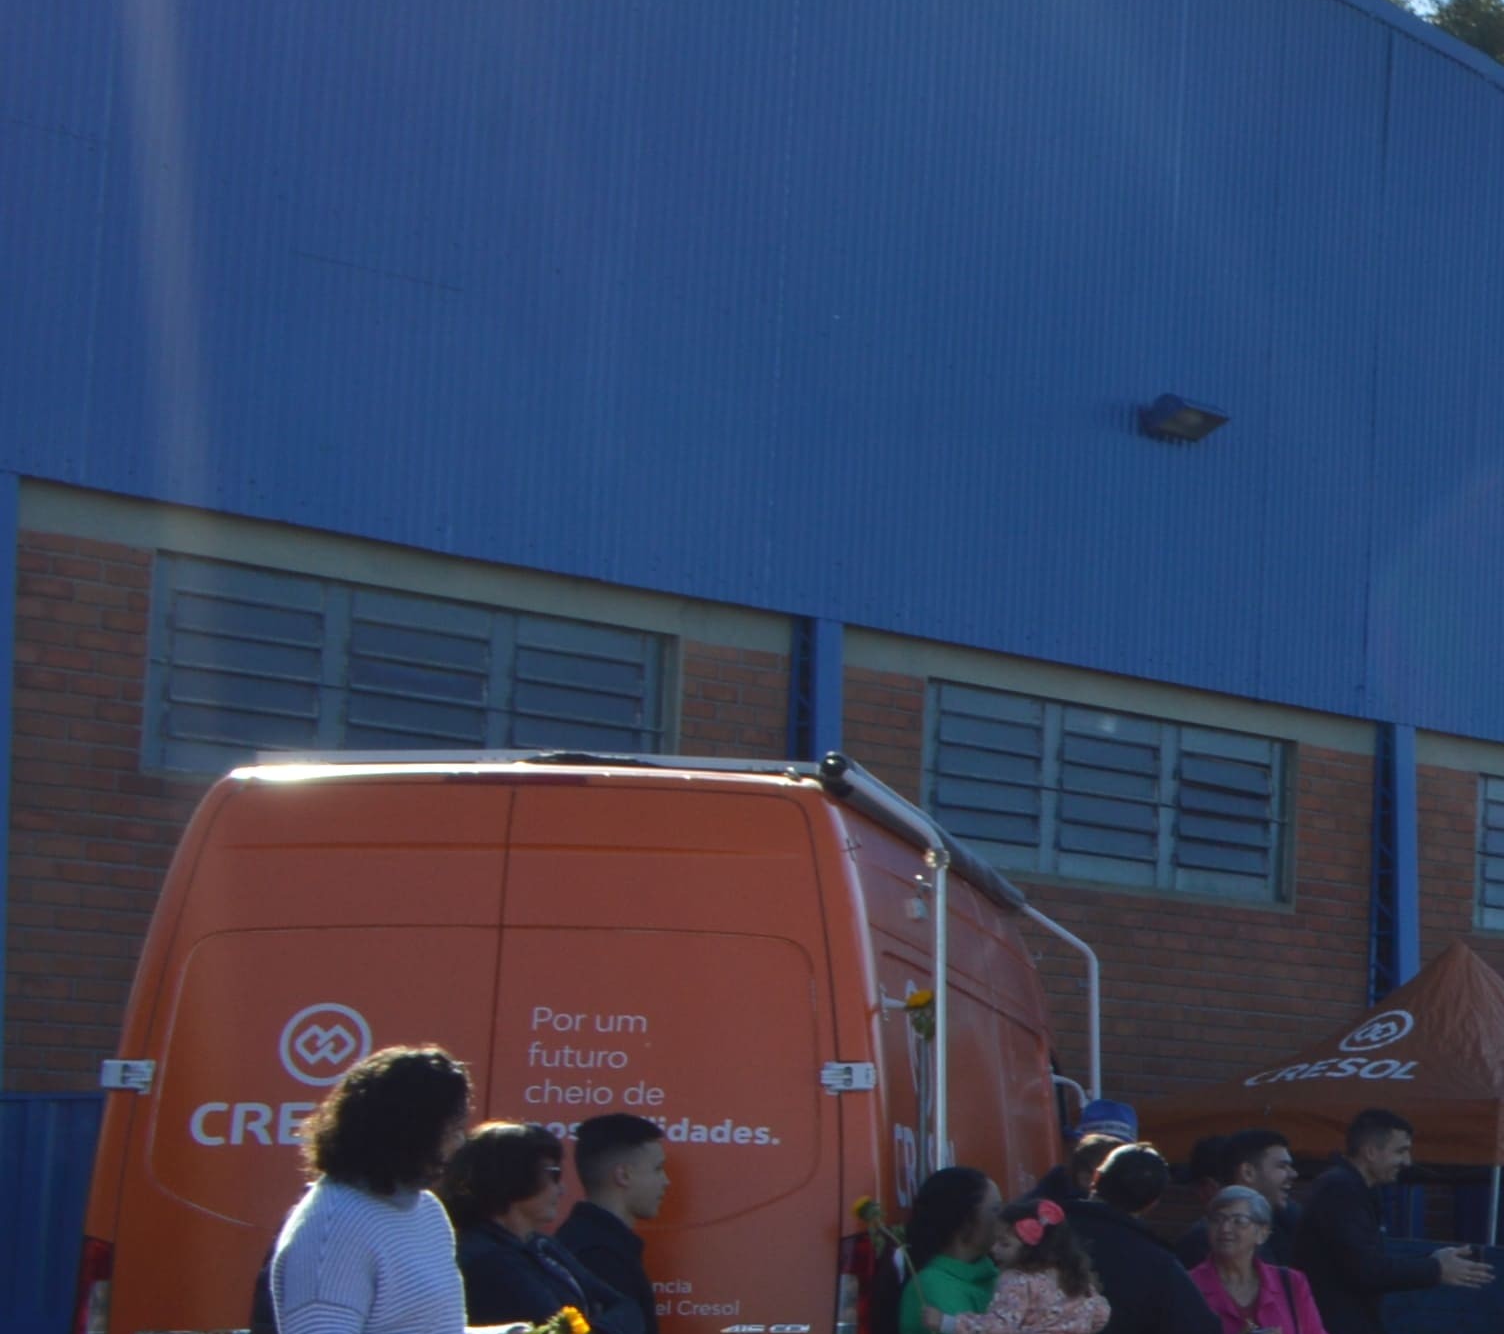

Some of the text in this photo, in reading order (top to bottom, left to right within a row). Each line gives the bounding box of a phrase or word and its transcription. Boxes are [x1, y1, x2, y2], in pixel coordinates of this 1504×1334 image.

[531, 1006, 648, 1033] Por um
[528, 1041, 628, 1069] futuro
[1243, 1056, 1420, 1088] CRESOL
[524, 1078, 665, 1107] cheio de
[189, 1100, 317, 1147] CRE
[651, 1278, 693, 1295] ncia
[676, 1299, 741, 1317] Cresol
